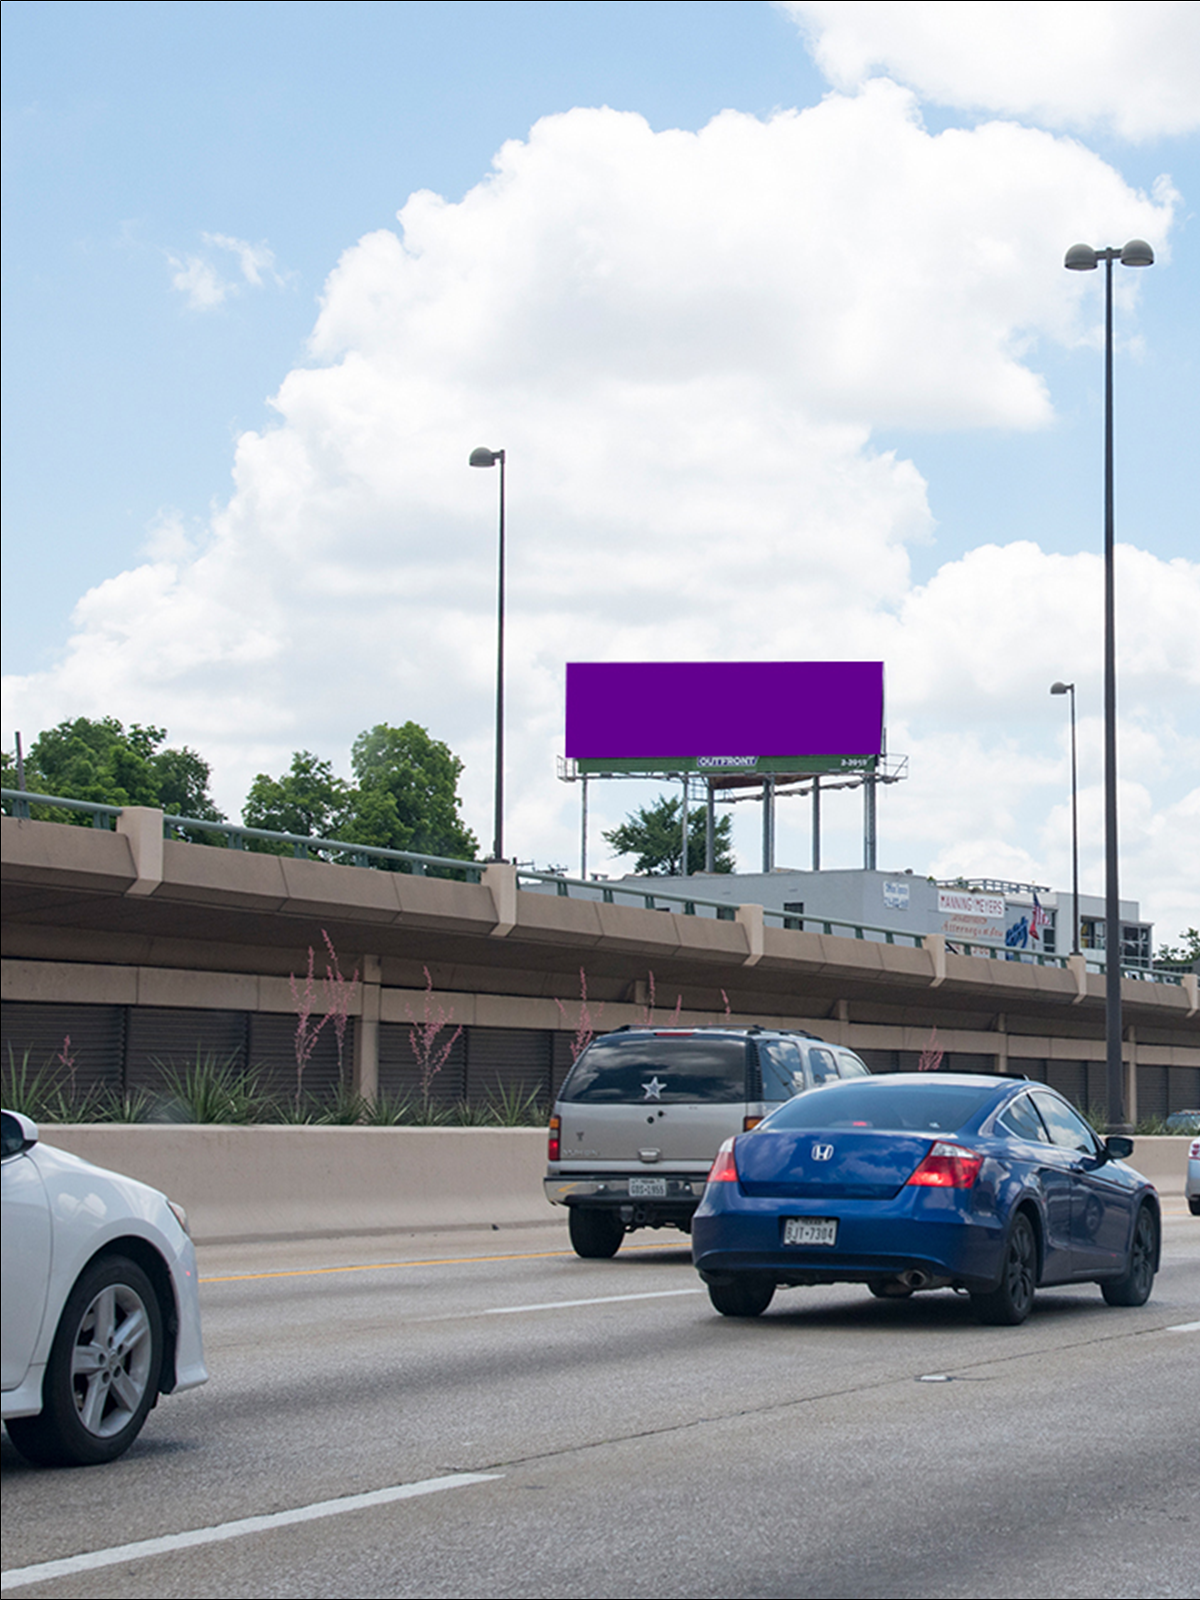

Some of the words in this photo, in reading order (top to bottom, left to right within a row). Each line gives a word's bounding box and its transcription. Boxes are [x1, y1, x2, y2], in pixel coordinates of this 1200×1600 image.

[699, 756, 756, 767] OUTFRONT
[940, 895, 972, 912] MANNING
[975, 898, 1003, 915] MEYERS
